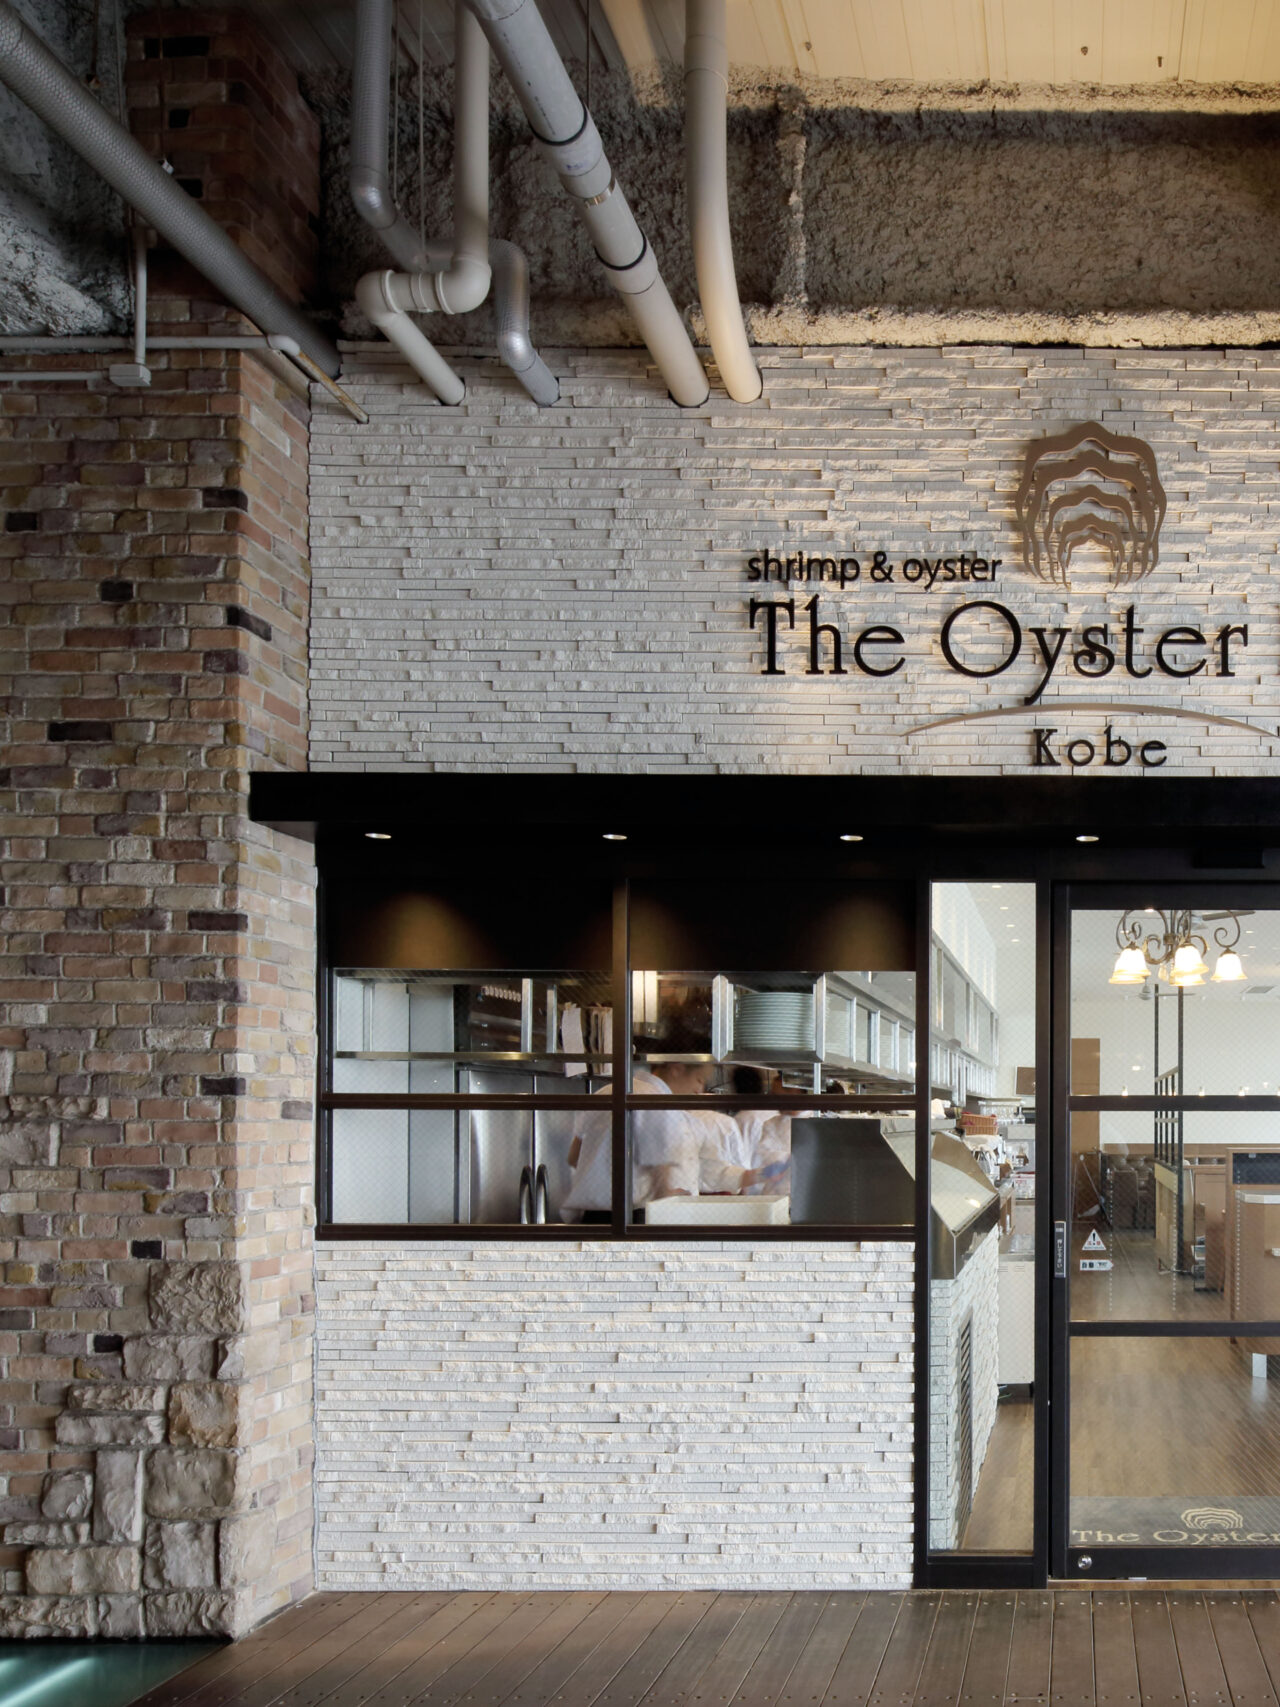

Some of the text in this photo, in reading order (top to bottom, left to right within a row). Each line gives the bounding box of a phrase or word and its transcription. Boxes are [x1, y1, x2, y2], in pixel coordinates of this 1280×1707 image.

[747, 549, 1002, 590] shrimp & oyster
[749, 594, 905, 677] The
[940, 600, 1249, 705] Oyster
[1033, 726, 1168, 768] Kobe
[1072, 1530, 1140, 1543] The
